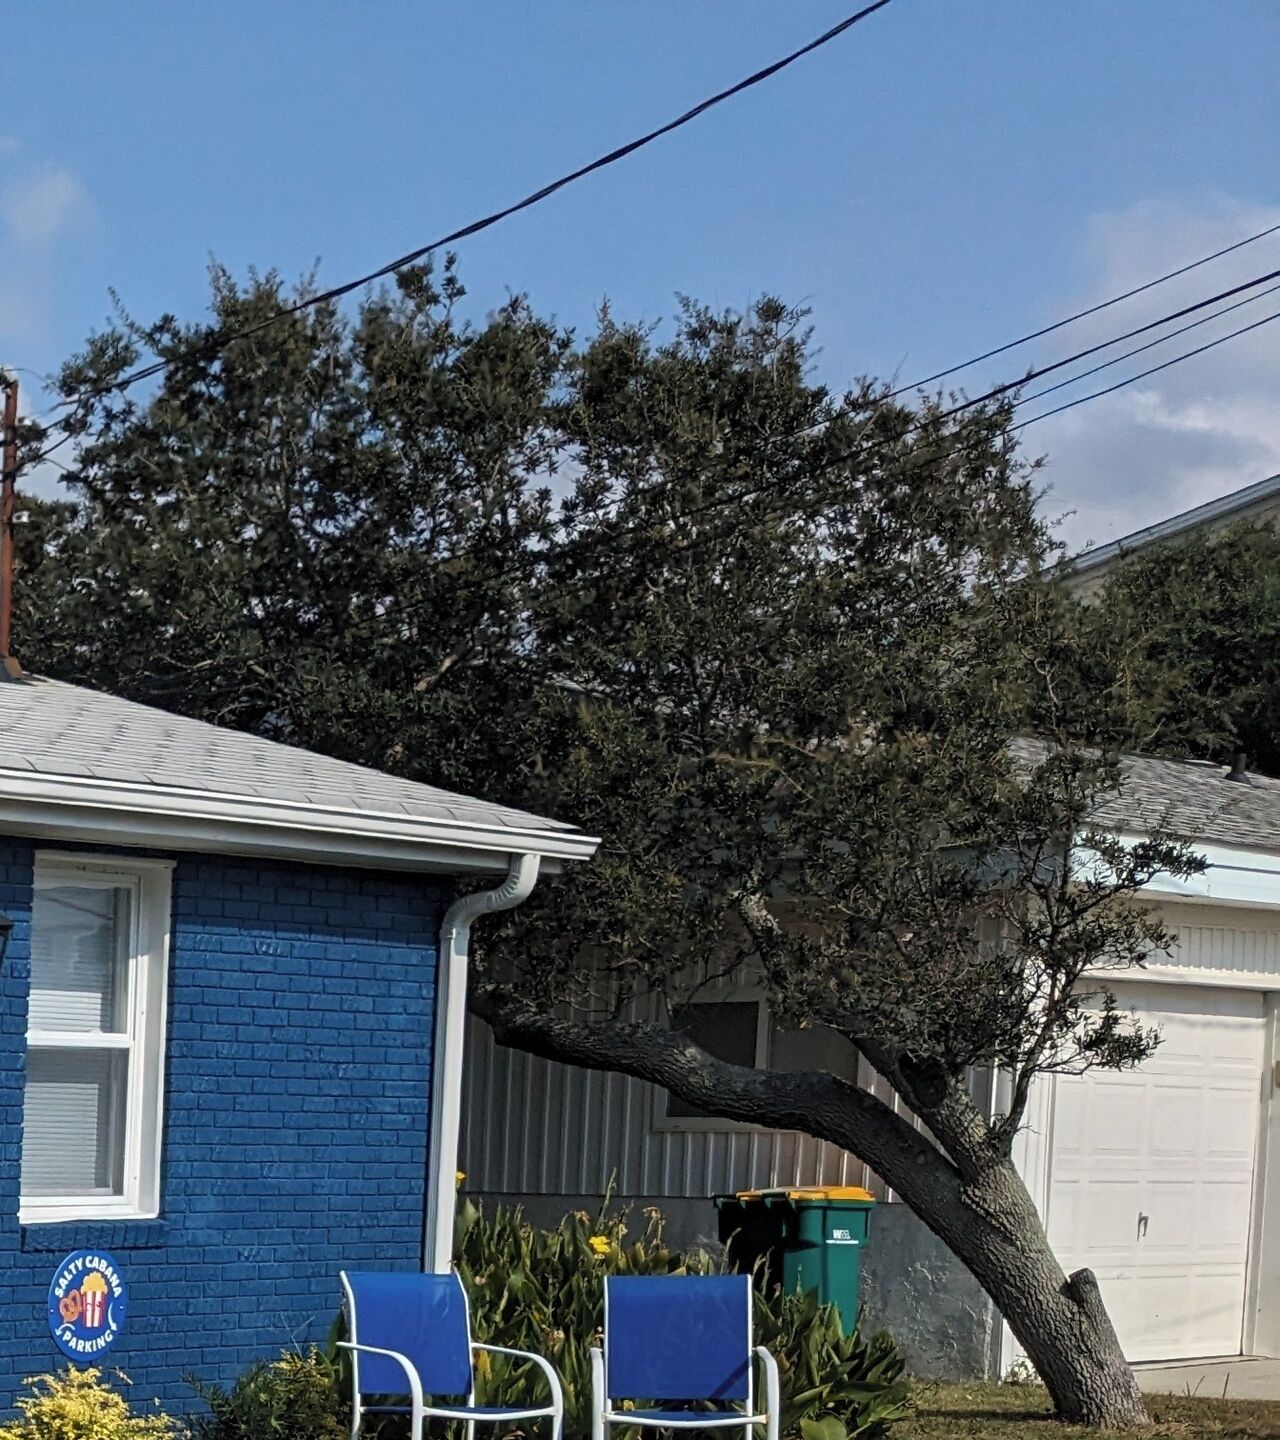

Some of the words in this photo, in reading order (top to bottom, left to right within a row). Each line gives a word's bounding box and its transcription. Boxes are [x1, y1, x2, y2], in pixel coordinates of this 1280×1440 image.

[54, 1257, 83, 1298] SALTY
[85, 1255, 123, 1298] CABANA
[62, 1329, 114, 1353] PARKING
